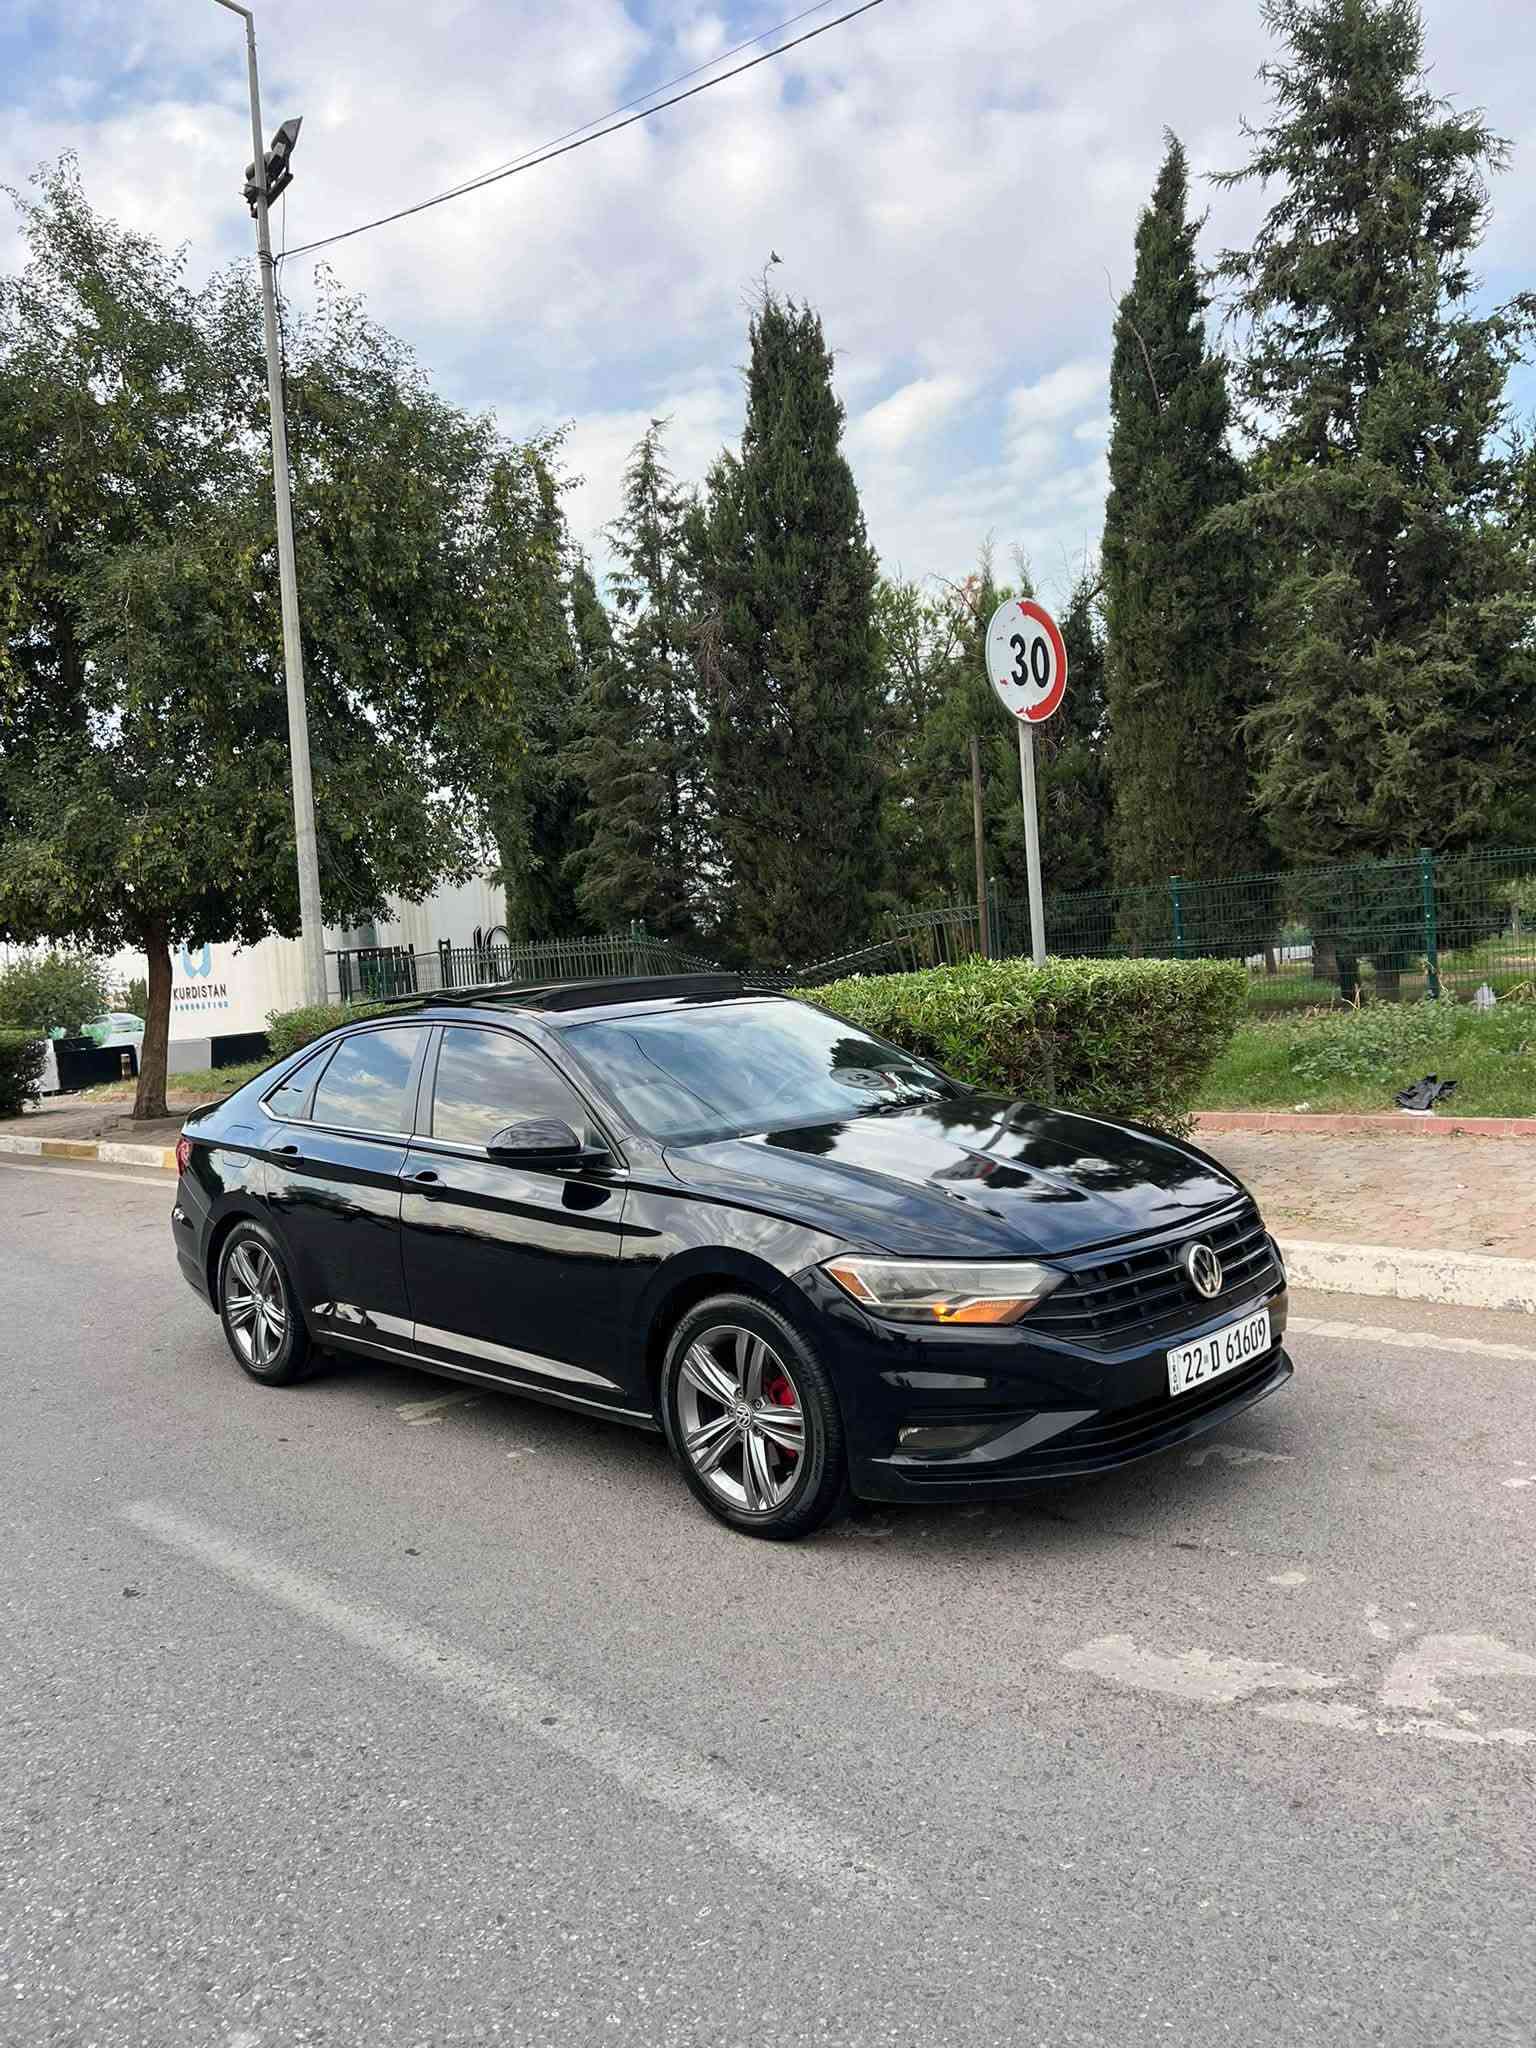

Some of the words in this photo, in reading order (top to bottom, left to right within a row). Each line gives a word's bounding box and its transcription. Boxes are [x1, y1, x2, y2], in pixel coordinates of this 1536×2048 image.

[1010, 632, 1050, 689] 30
[173, 983, 227, 1000] KURDISTAN
[1183, 1347, 1204, 1384] 22
[1210, 1340, 1220, 1372] D
[1226, 1317, 1266, 1364] 61609
